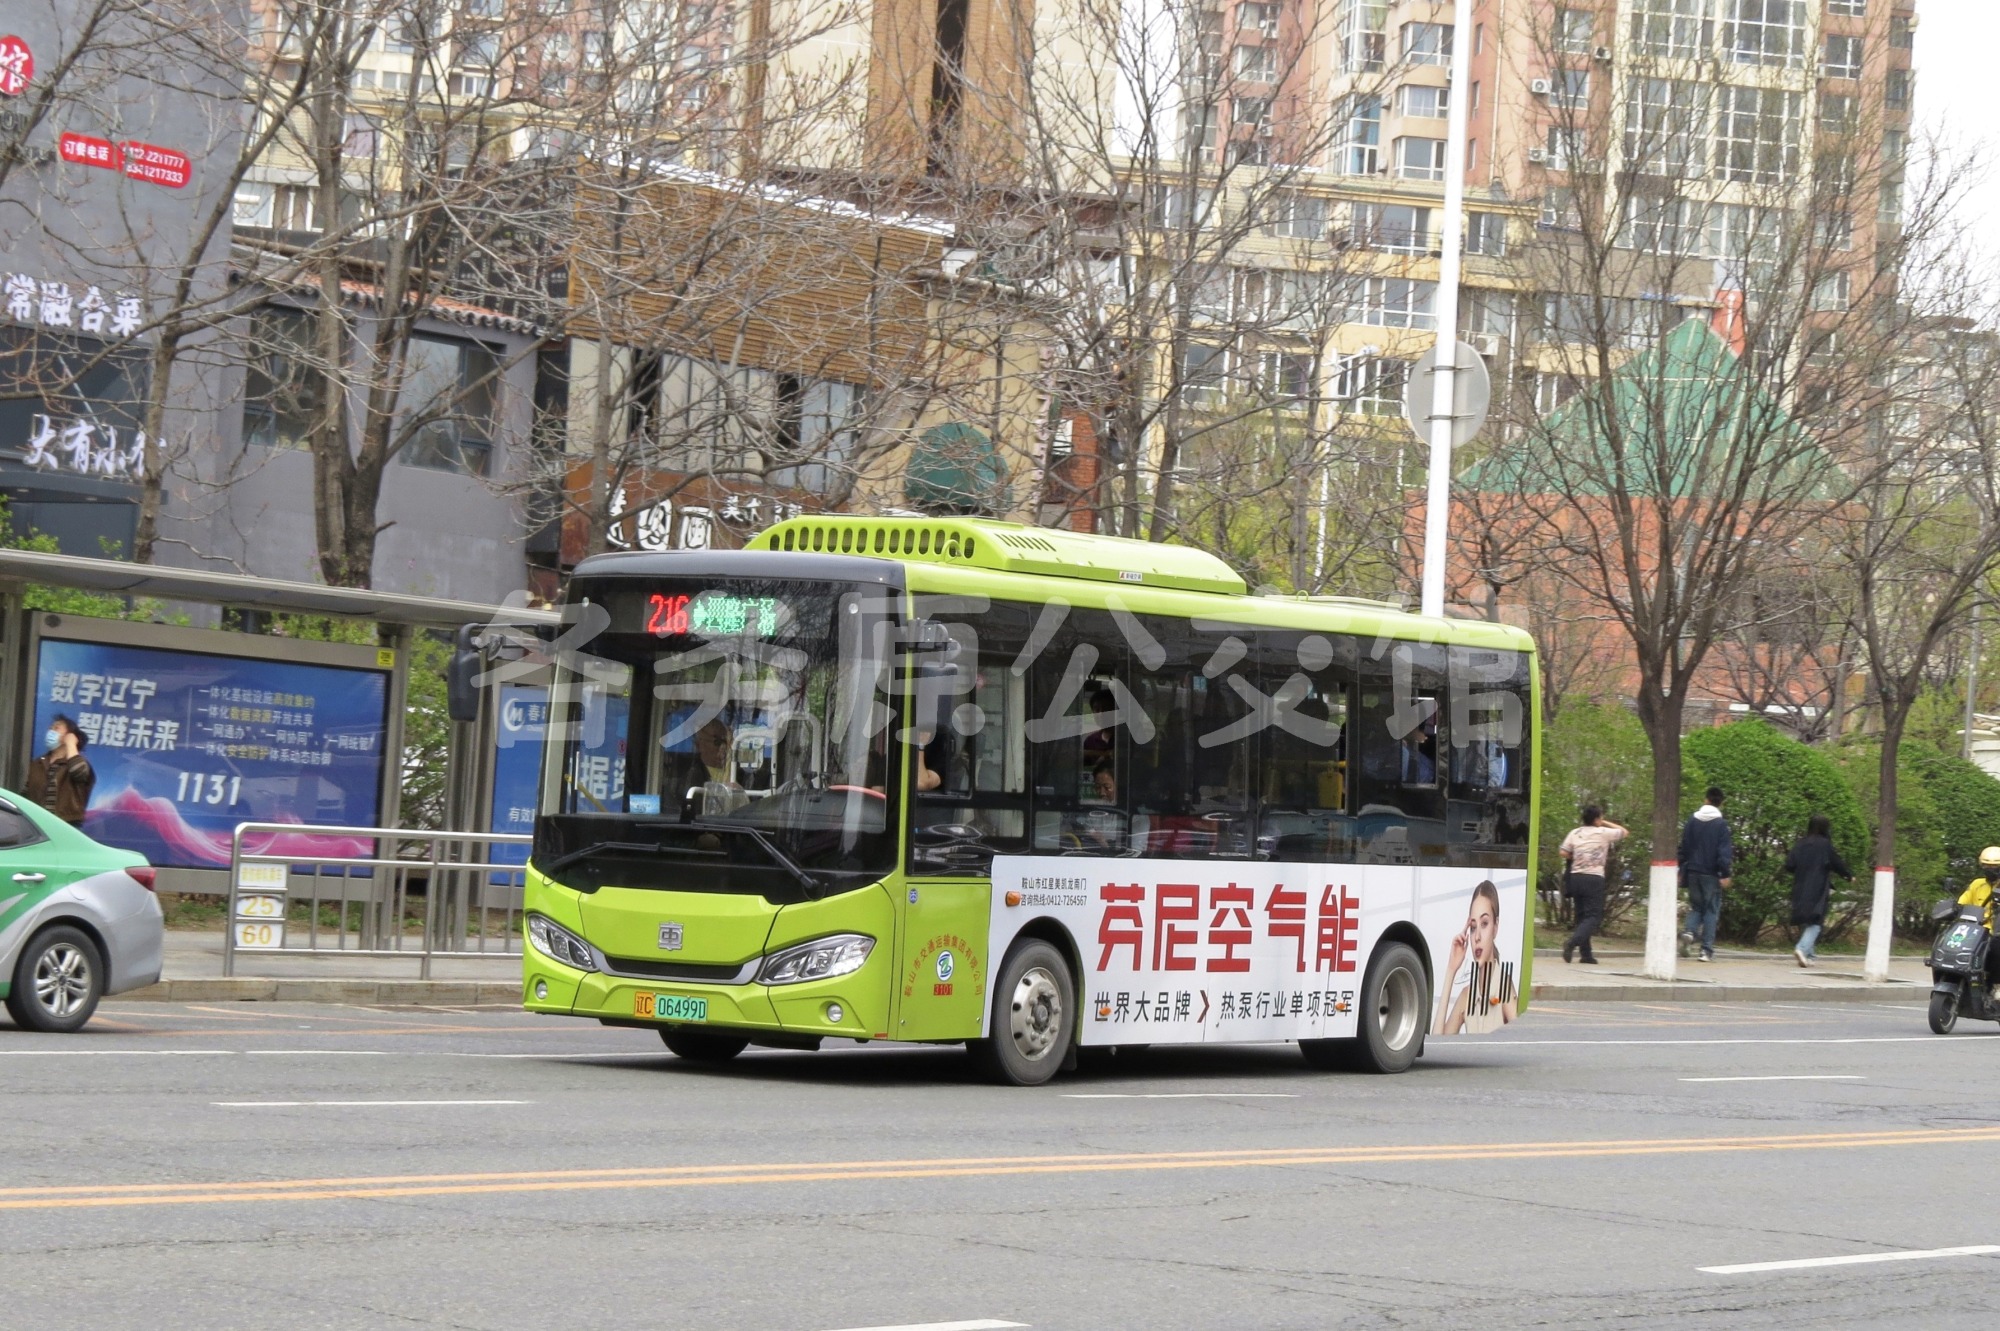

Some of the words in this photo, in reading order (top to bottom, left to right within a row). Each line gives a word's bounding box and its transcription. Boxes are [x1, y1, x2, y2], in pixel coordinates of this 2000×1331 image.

[64, 140, 109, 161] 订餐电话
[0, 272, 143, 337] 常融合菜
[647, 594, 690, 634] 216
[50, 671, 157, 710] 数字辽宁
[79, 712, 180, 751] 智链未来
[177, 772, 241, 806] 1131
[1021, 877, 1087, 890] 鞍山市红星美凯龙南门
[244, 897, 274, 915] 25
[242, 924, 272, 945] 60
[1096, 882, 1360, 973] 芬尼空气能
[636, 996, 653, 1014] 辽C
[658, 998, 706, 1019] 06499D
[1094, 990, 1192, 1023] 世界大品牌
[1220, 990, 1355, 1020] 热泵行业单项冠军
